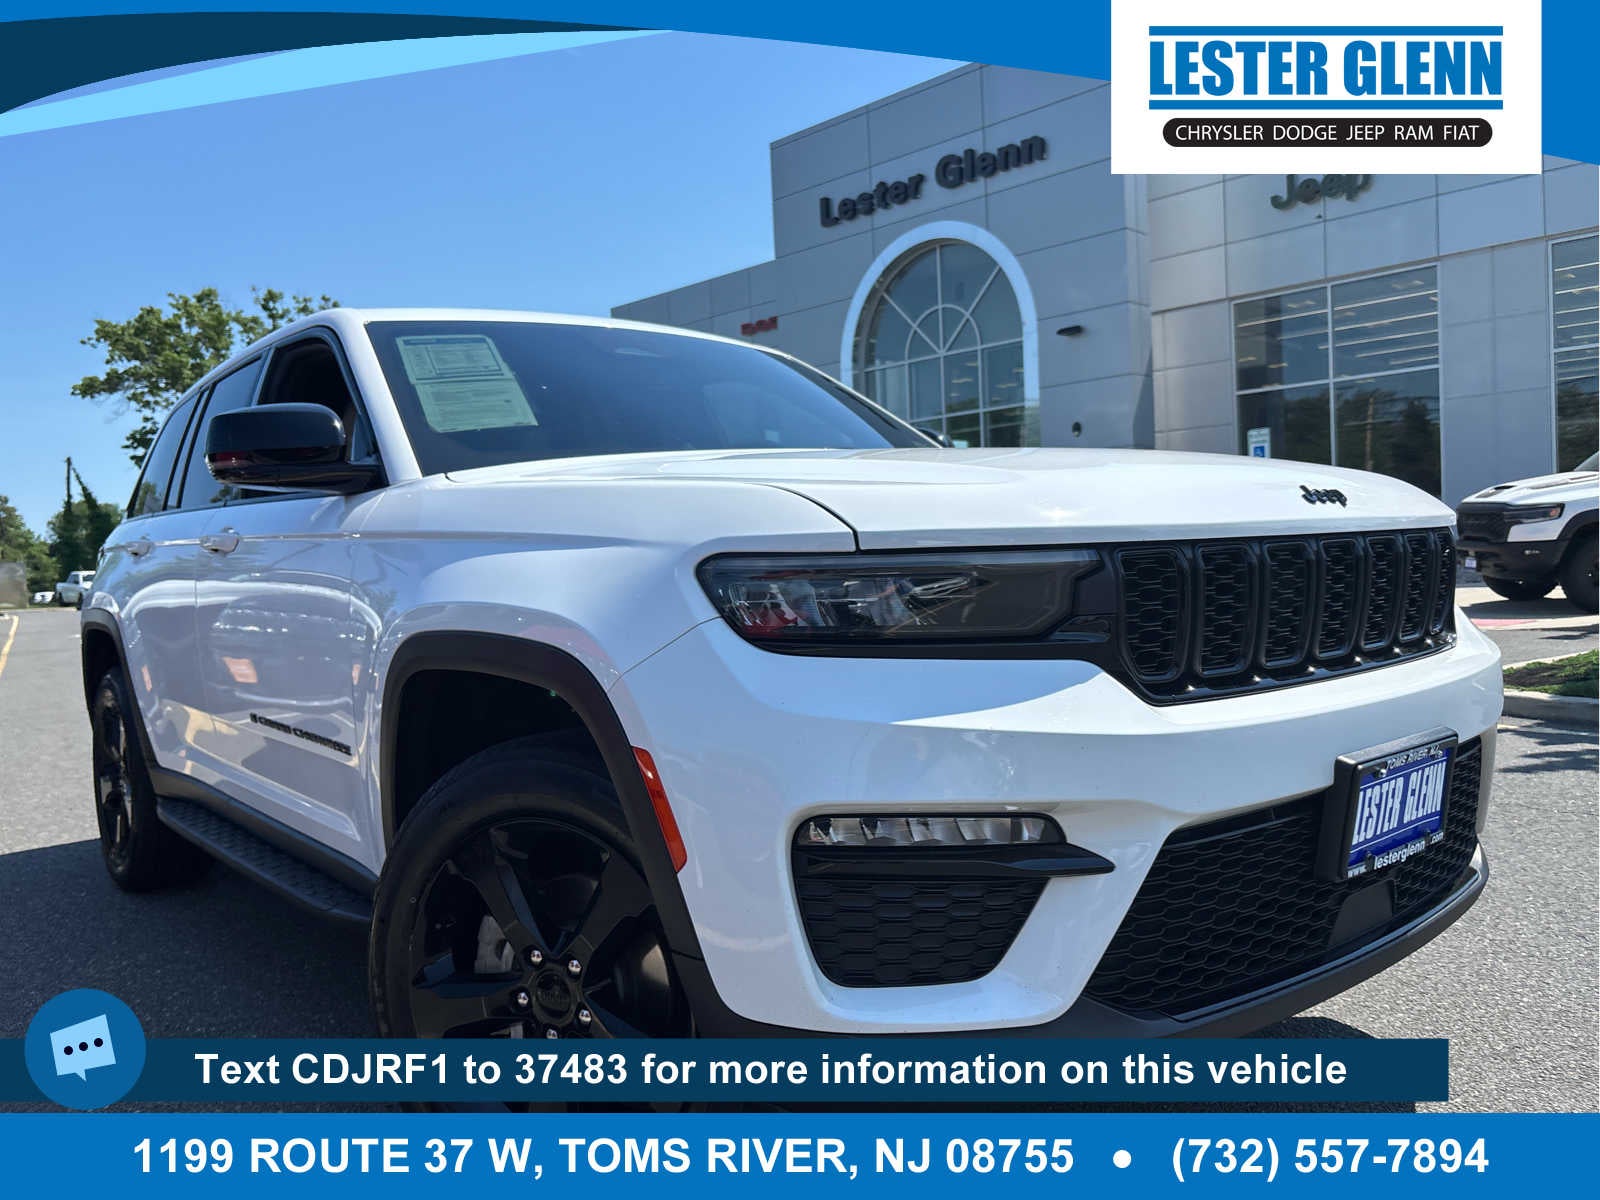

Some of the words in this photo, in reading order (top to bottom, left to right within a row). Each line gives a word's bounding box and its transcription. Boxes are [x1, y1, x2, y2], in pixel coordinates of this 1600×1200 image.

[819, 173, 926, 227] Lester
[935, 136, 1048, 189] Glenn
[1270, 174, 1374, 210] Jeep
[1299, 484, 1348, 508] Jeep
[1351, 776, 1404, 846] LESTER
[1404, 761, 1447, 824] GLENN
[1374, 839, 1426, 870] lesterglenn
